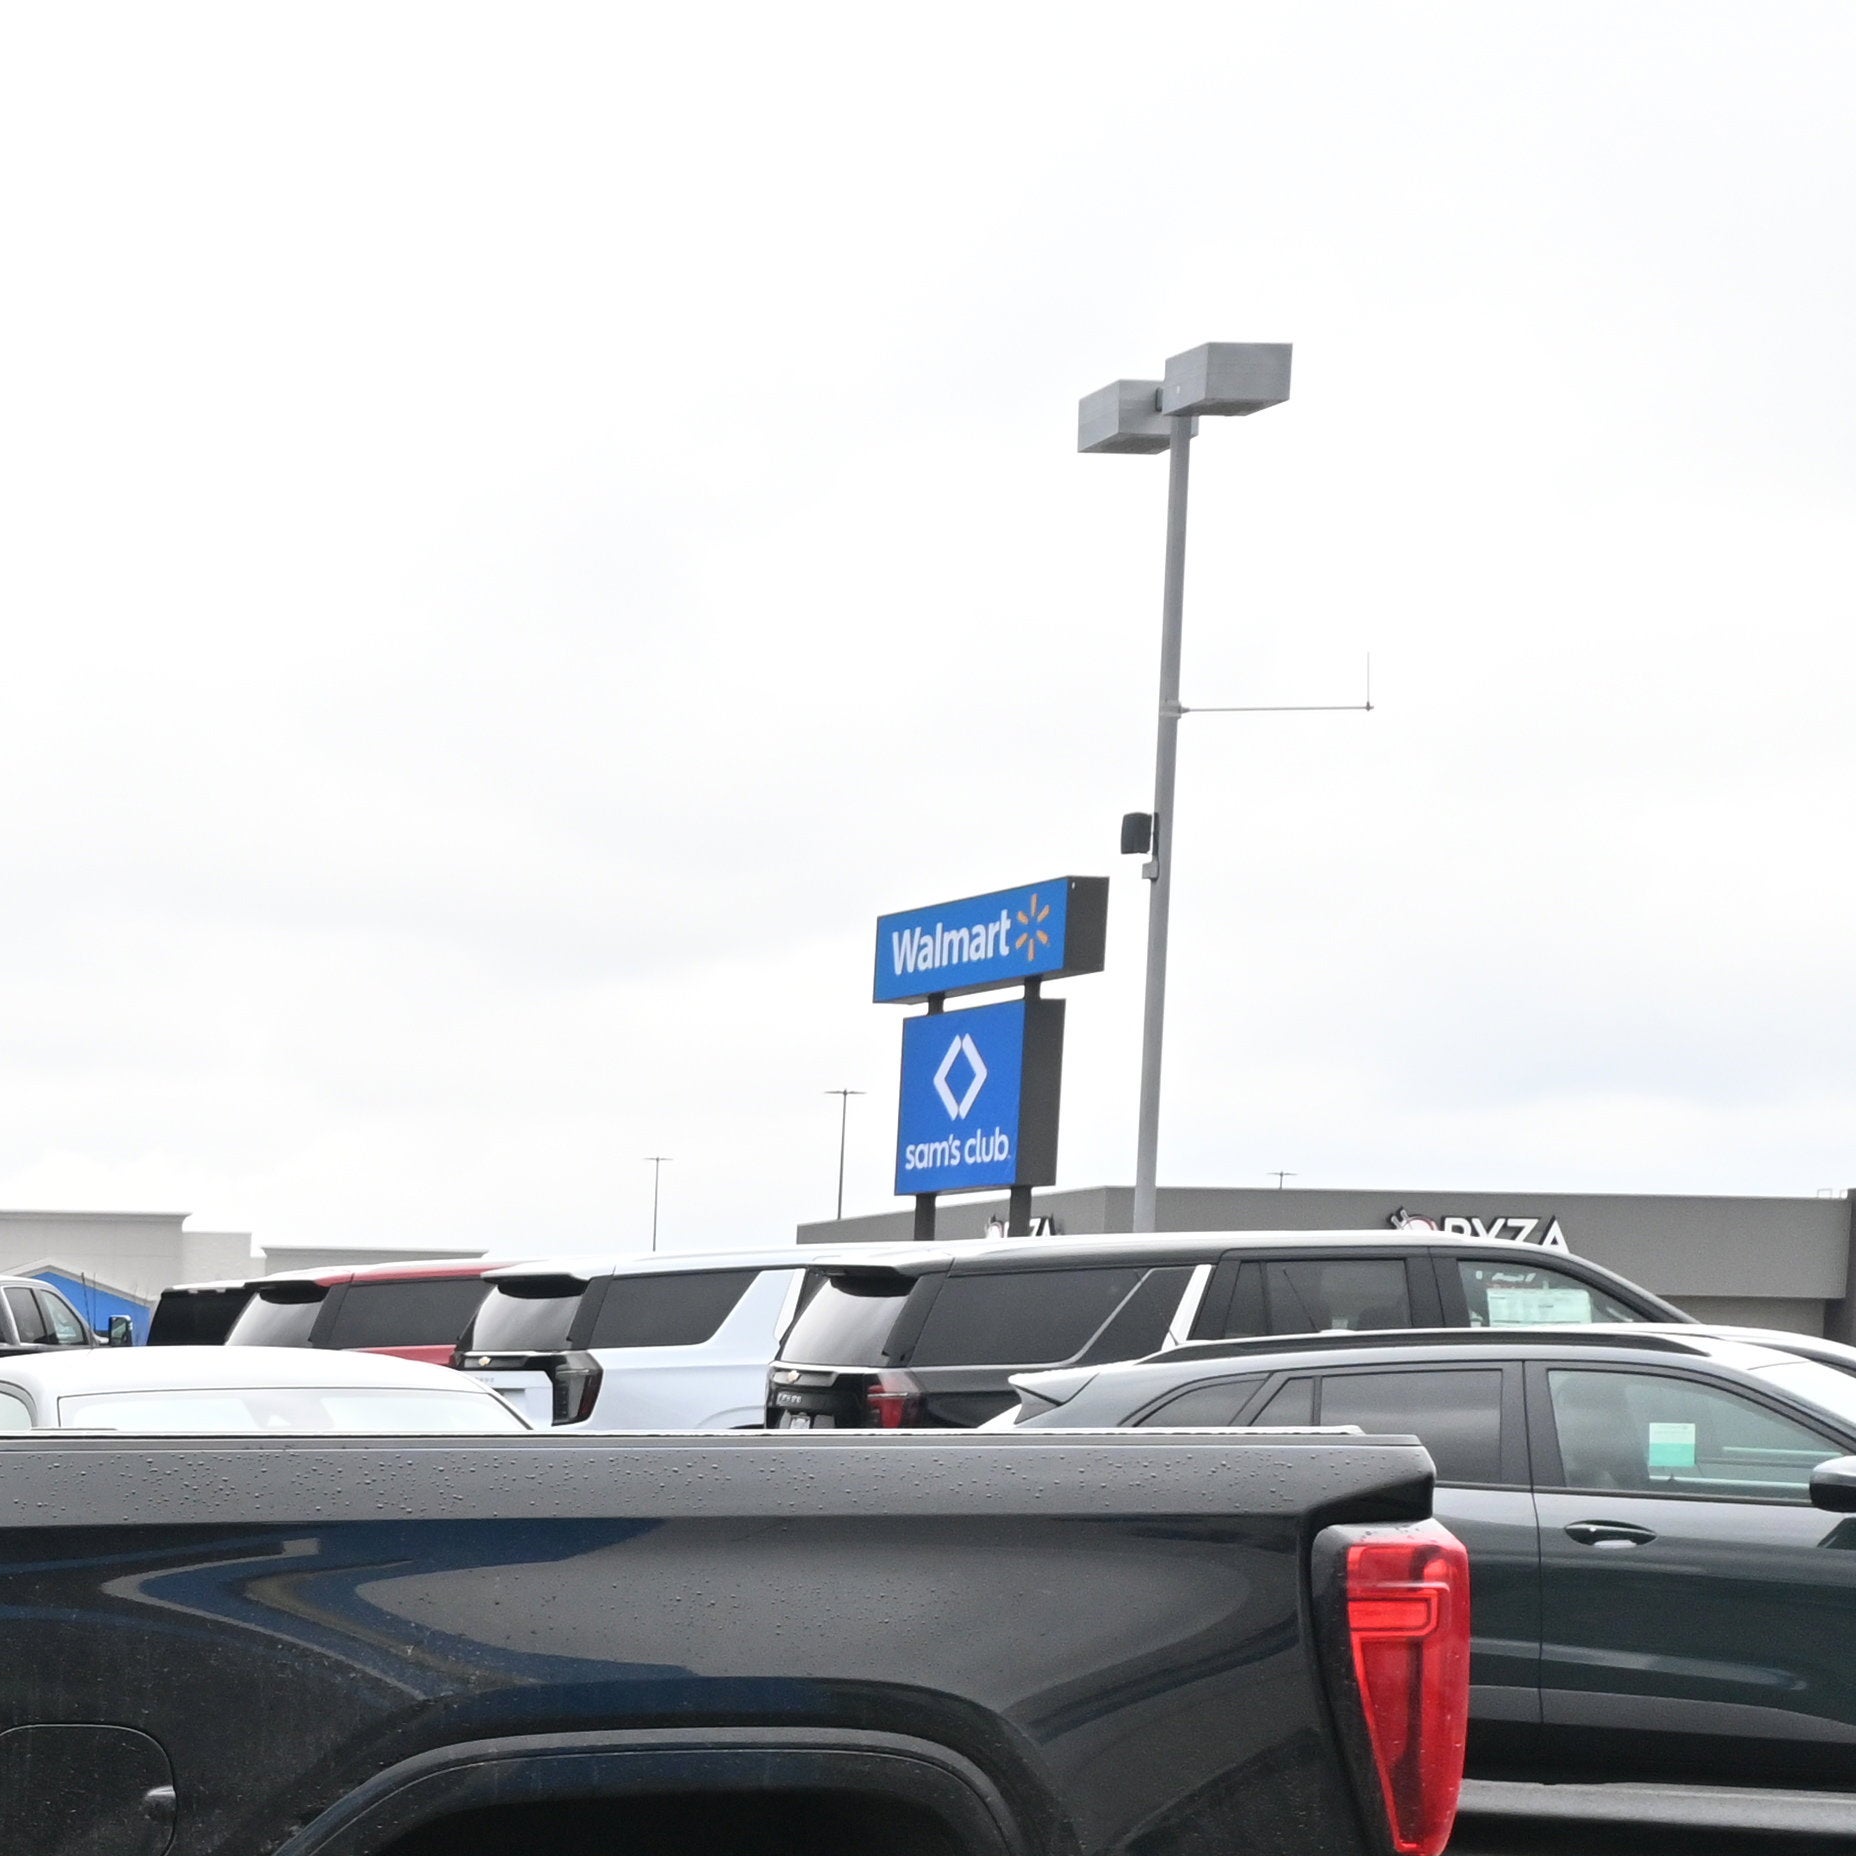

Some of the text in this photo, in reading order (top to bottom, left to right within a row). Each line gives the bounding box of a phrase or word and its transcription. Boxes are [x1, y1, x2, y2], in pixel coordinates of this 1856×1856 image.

[892, 908, 1011, 976] Walmart
[905, 1126, 1009, 1170] sam's club
